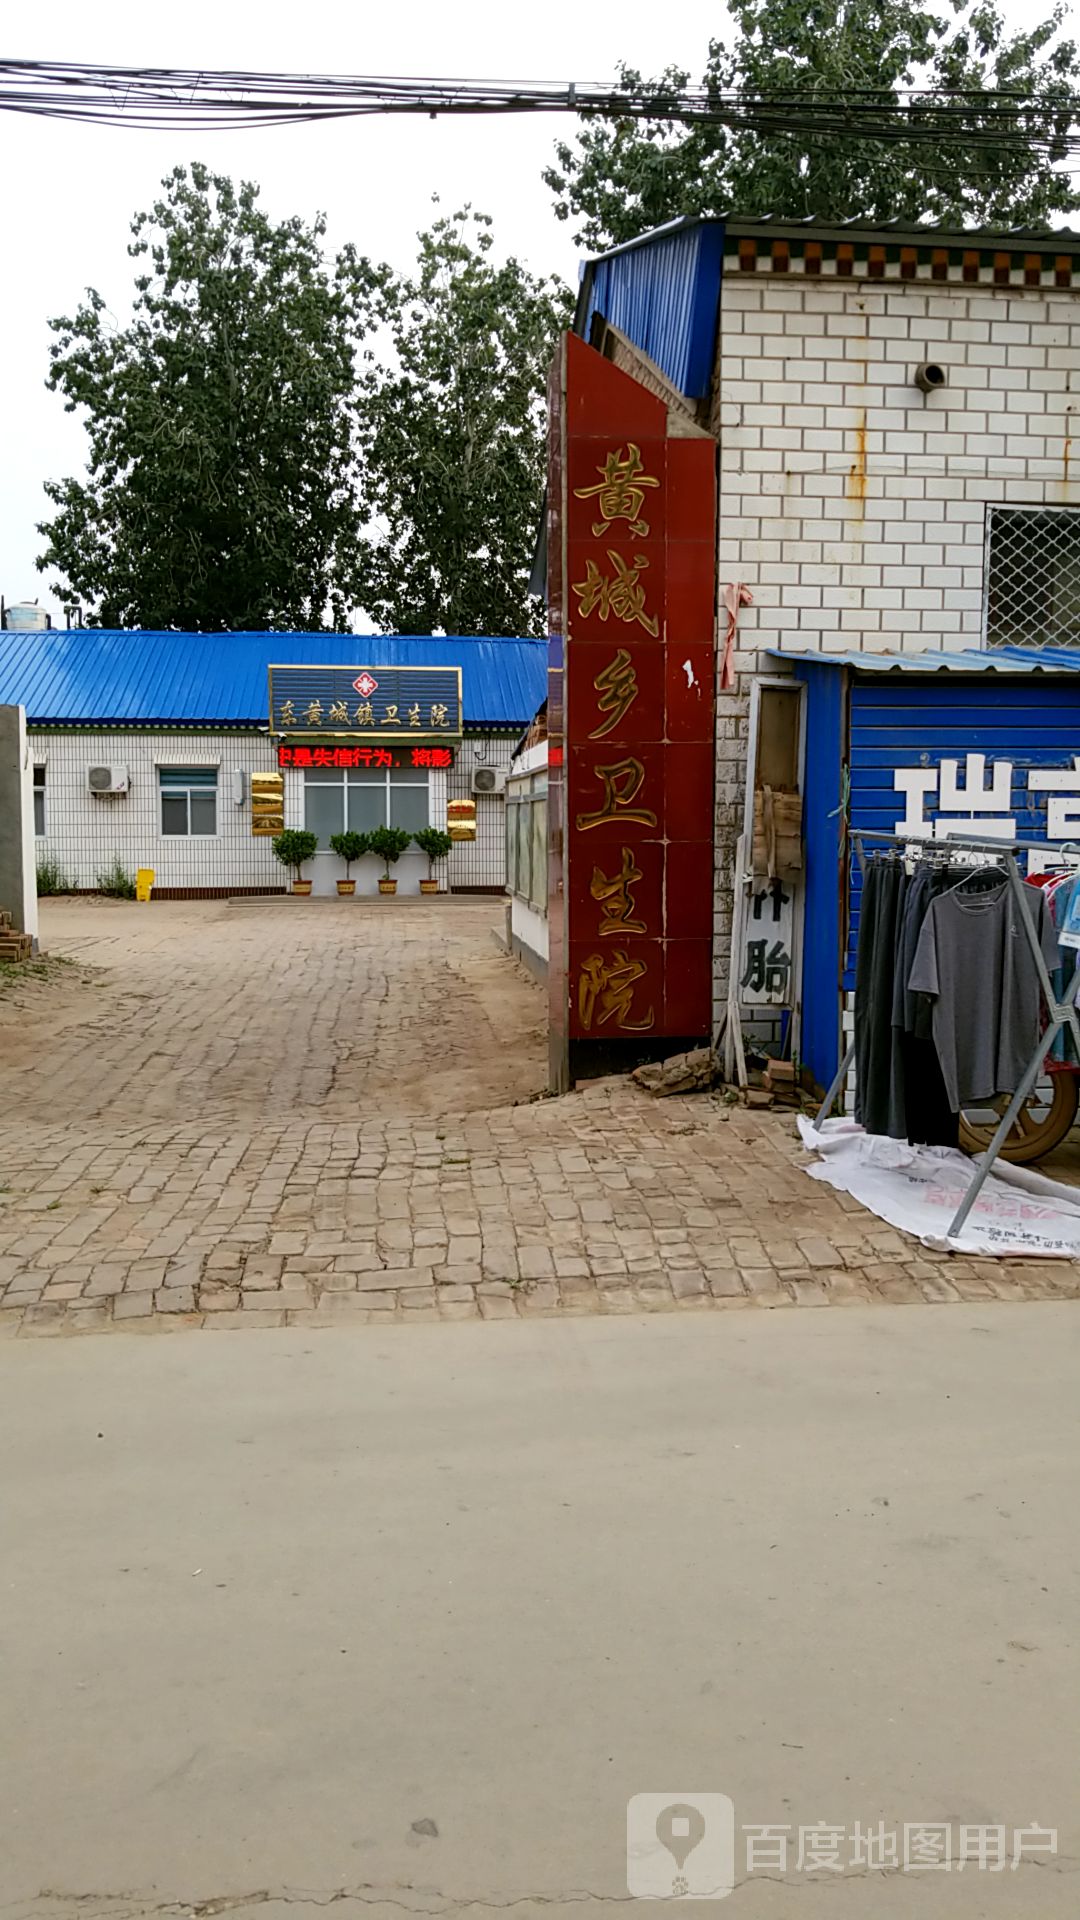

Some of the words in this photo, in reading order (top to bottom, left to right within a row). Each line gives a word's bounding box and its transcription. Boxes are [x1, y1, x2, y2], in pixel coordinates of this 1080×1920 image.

[279, 700, 451, 727] 东黄城镇卫生院
[572, 442, 661, 1032] 黄城乡卫生院
